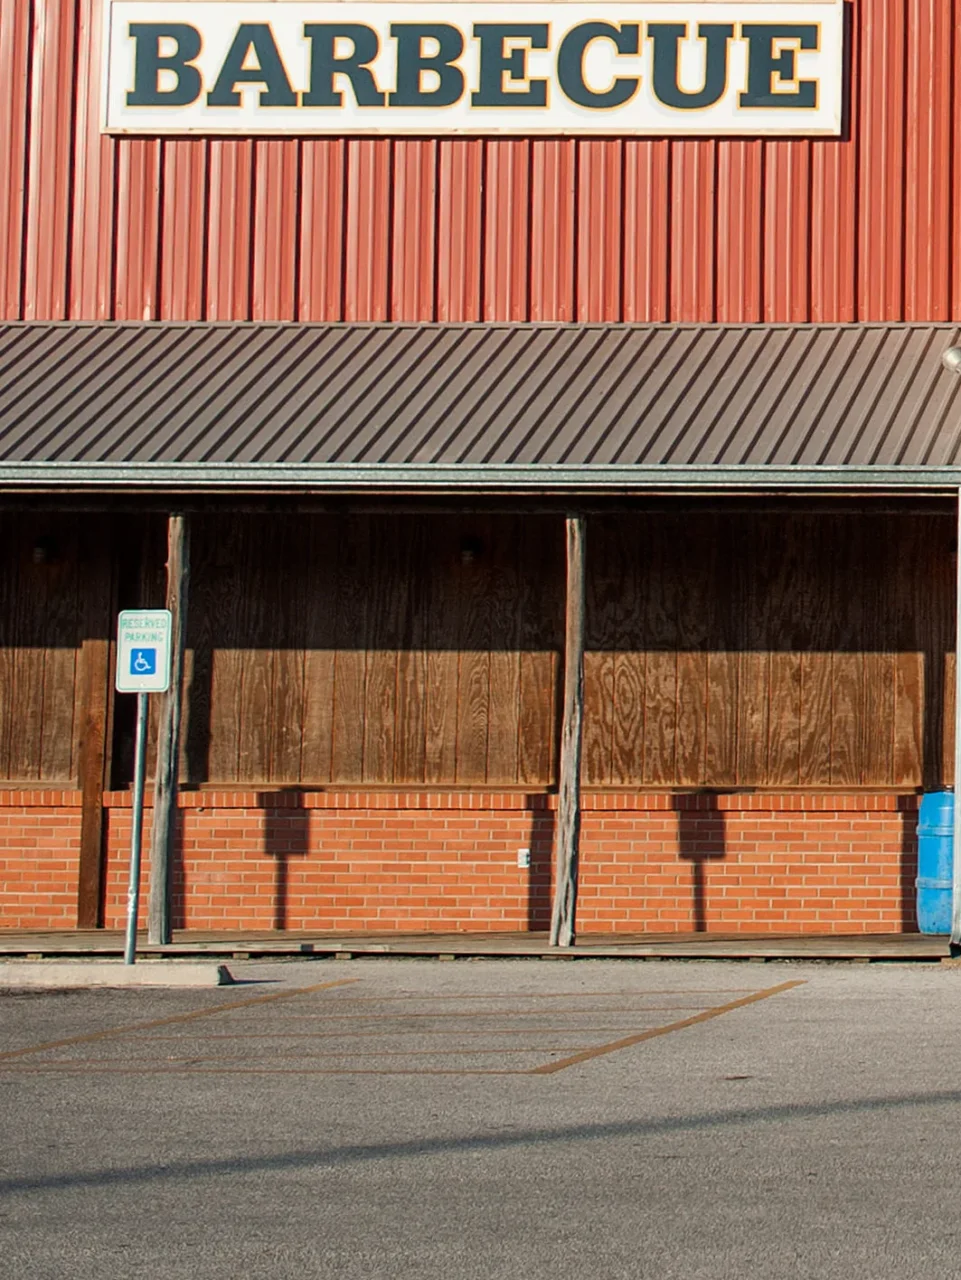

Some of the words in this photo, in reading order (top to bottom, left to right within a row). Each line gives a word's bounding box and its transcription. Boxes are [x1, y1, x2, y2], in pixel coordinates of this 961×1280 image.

[124, 21, 821, 111] BARBECUE
[121, 618, 167, 629] RESERVED
[124, 631, 164, 641] PARKING
